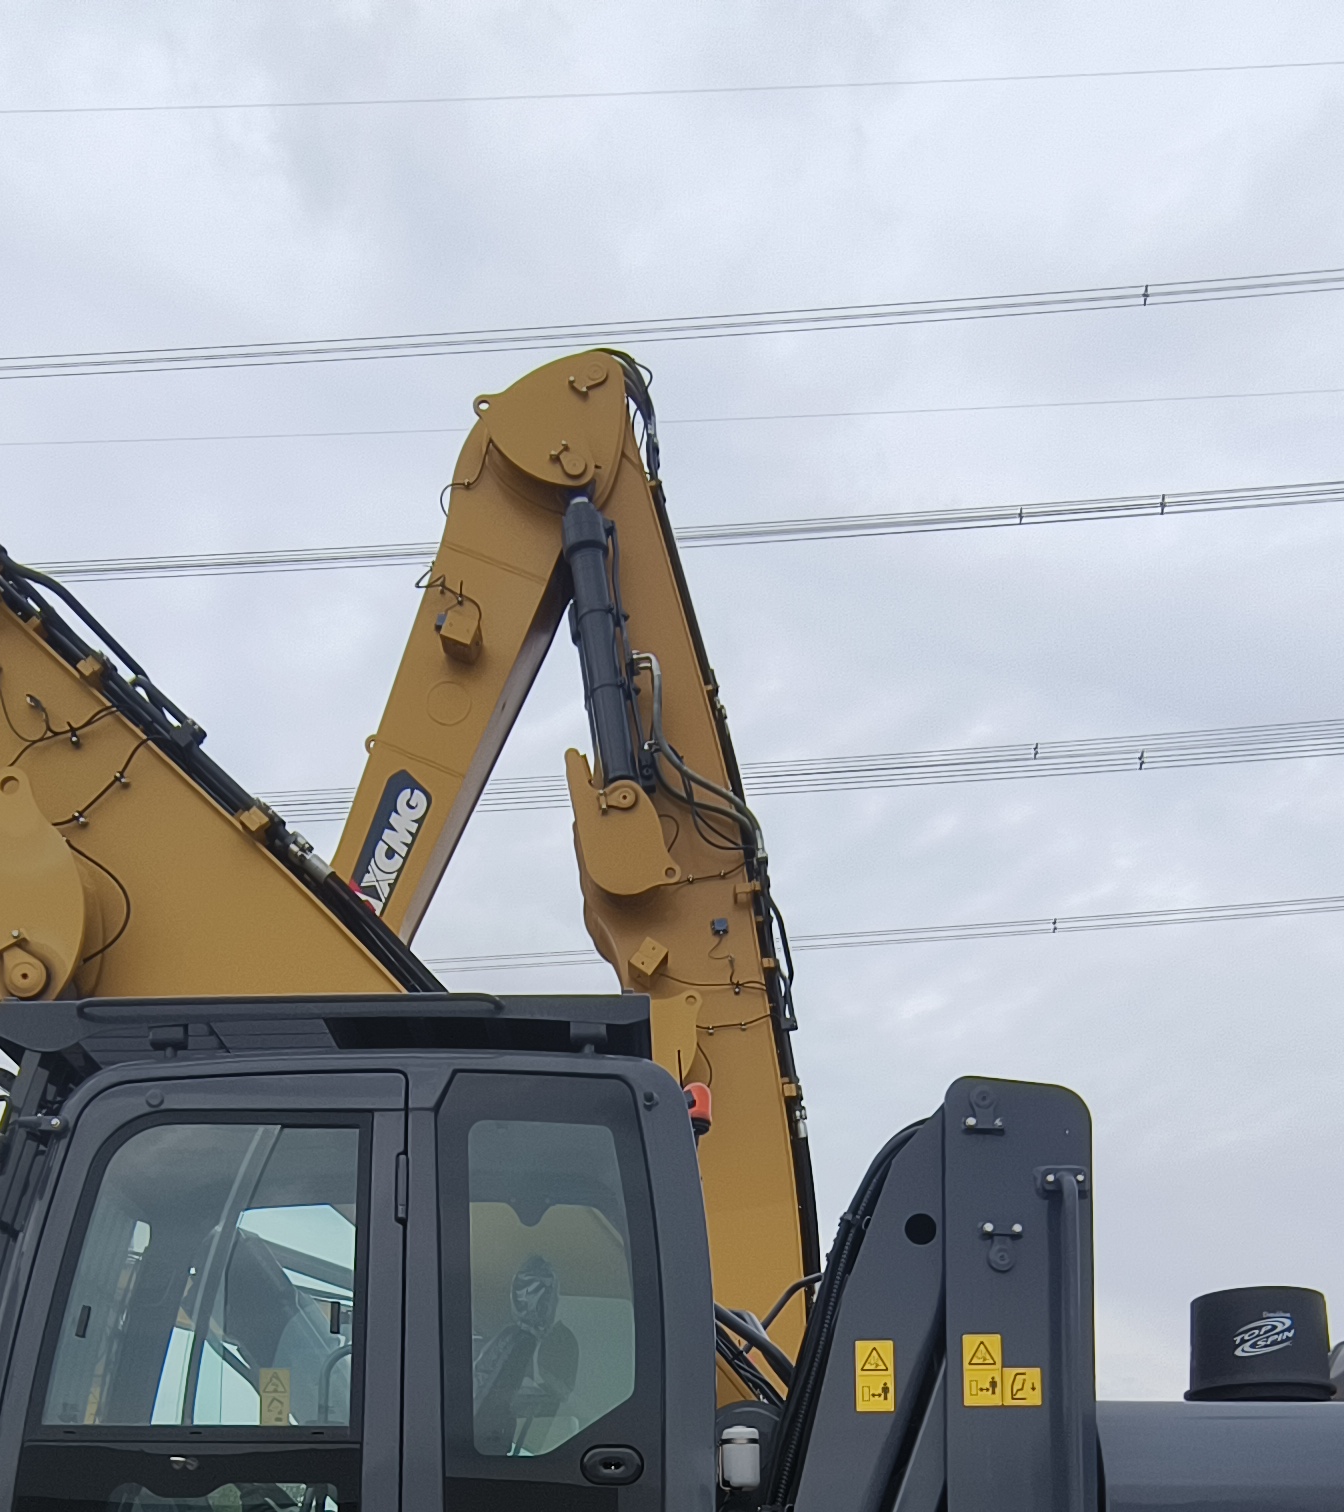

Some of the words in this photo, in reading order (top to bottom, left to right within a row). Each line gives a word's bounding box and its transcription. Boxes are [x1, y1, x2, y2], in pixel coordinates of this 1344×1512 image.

[360, 788, 428, 904] XCMG
[1233, 1325, 1272, 1345] TOP
[1256, 1329, 1295, 1347] SPIN
